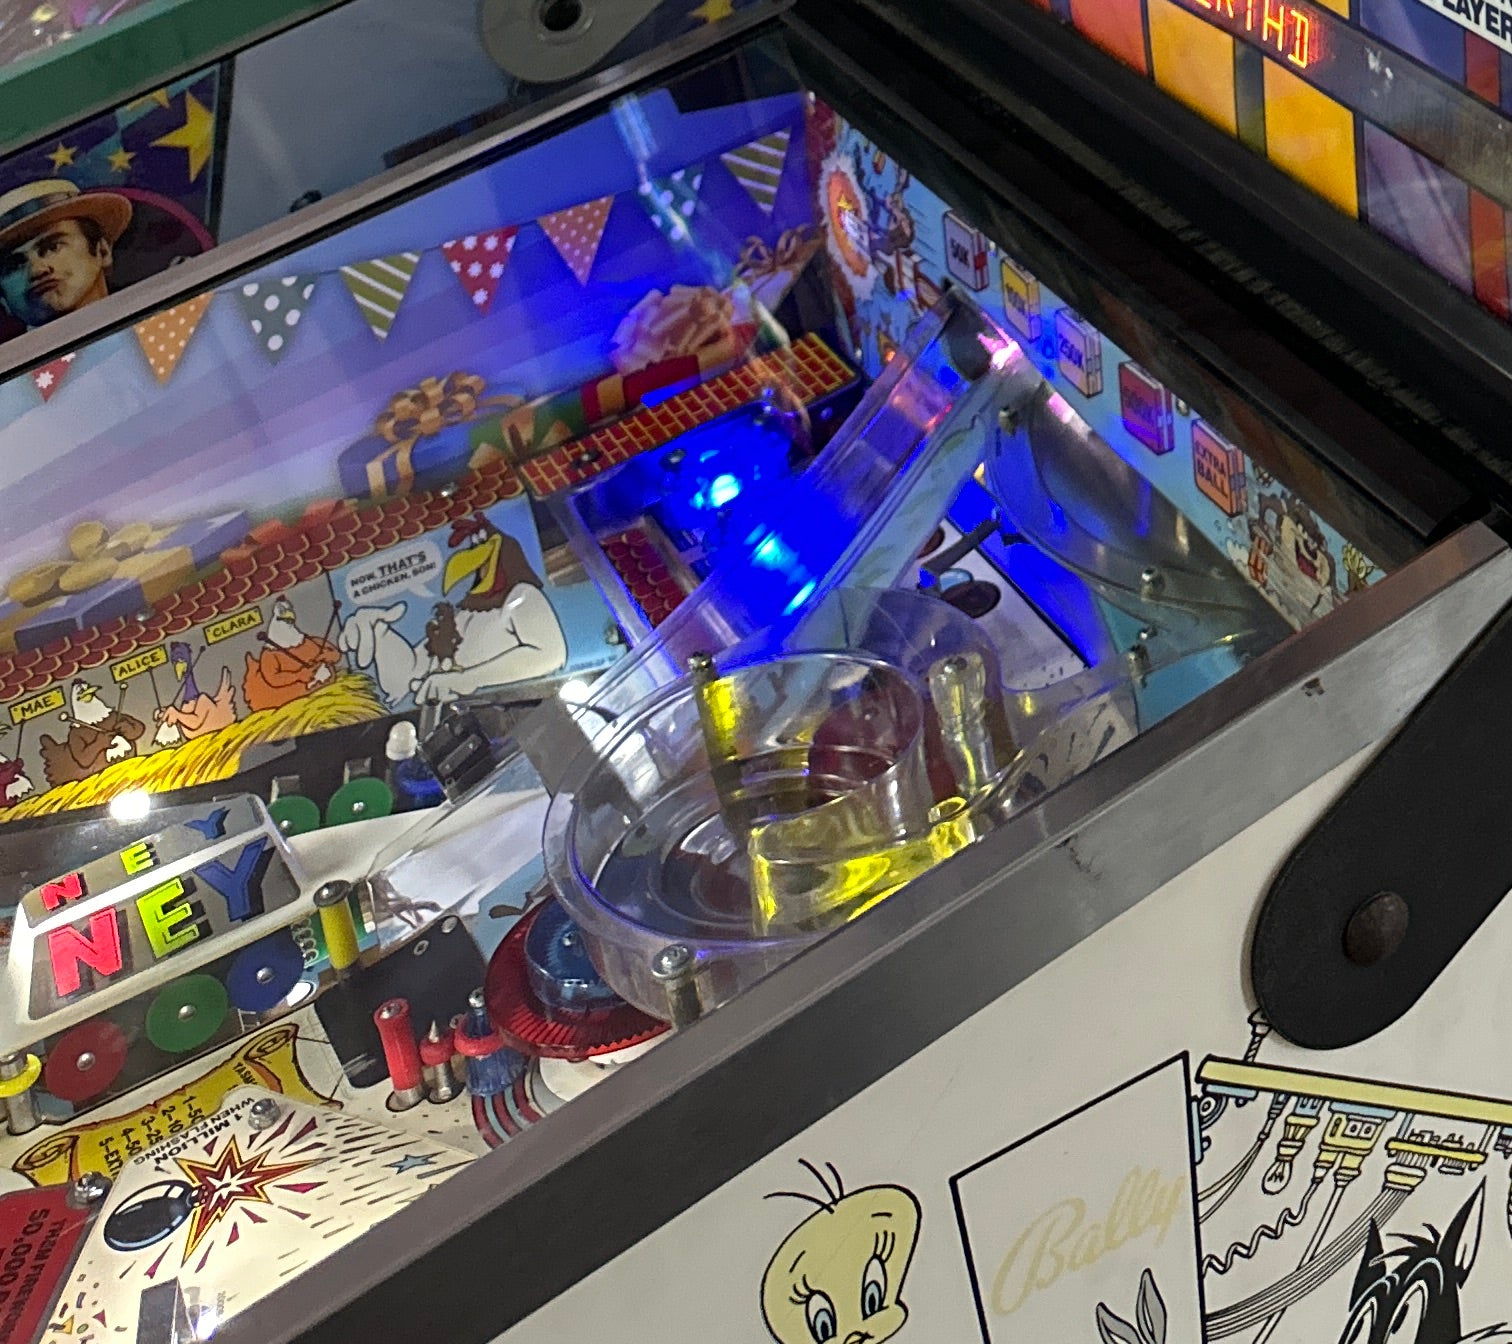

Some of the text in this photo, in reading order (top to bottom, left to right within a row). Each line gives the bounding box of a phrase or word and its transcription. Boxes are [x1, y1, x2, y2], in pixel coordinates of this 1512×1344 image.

[133, 1096, 255, 1165] WHEN FLASHING
[154, 1120, 231, 1165] MILLION
[991, 1165, 1186, 1316] Bally
